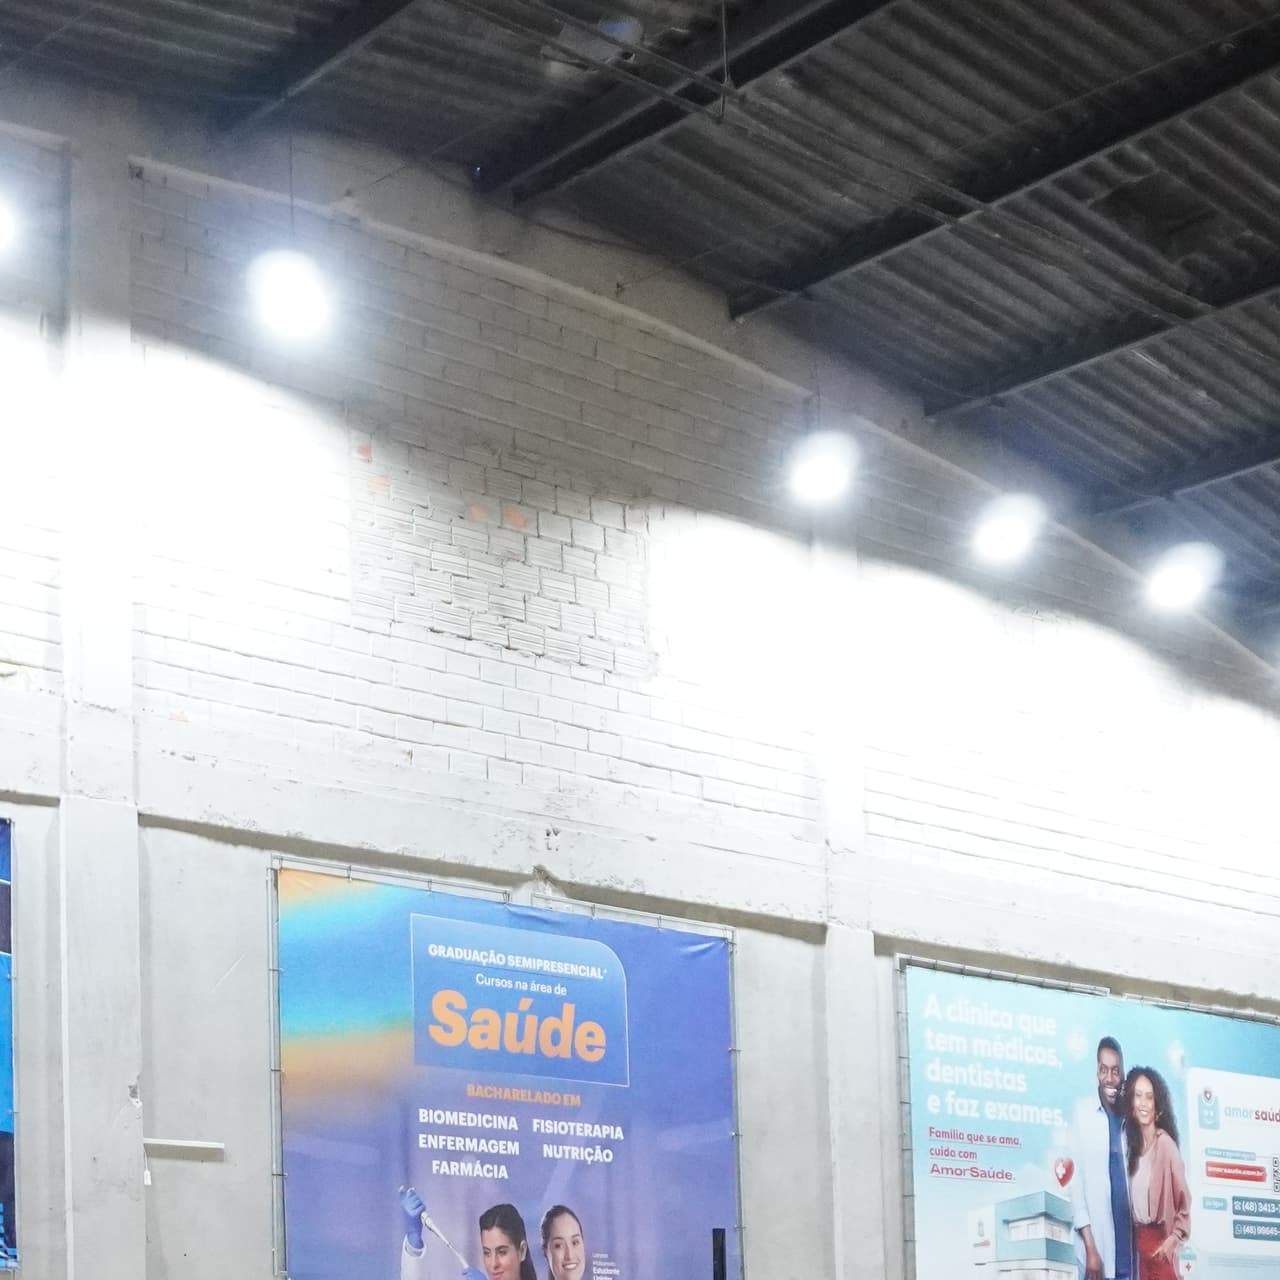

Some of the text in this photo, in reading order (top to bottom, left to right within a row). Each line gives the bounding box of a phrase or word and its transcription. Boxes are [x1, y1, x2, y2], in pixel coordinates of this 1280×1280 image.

[428, 944, 506, 966] GRADUAÇÃO
[476, 973, 567, 996] Cursos na área de
[428, 989, 606, 1062] Saúde
[924, 993, 943, 1020] A
[1019, 1013, 1057, 1039] que
[925, 1028, 1063, 1070] tem médicos,
[927, 1057, 1027, 1092] dentistas
[466, 1084, 581, 1105] BACHARELADO EM
[419, 1108, 518, 1131] BIOMEDICINA
[927, 1090, 1068, 1127] e faz exames.
[532, 1119, 625, 1141] FISIOTERAPIA
[967, 1133, 984, 1144] que
[418, 1134, 520, 1156] ENFERMAGEM
[543, 1143, 614, 1165] NUTRIÇÃO
[929, 1146, 977, 1160] cuida com
[432, 1158, 509, 1180] FARMÁCIA
[1242, 1200, 1257, 1213] (48)
